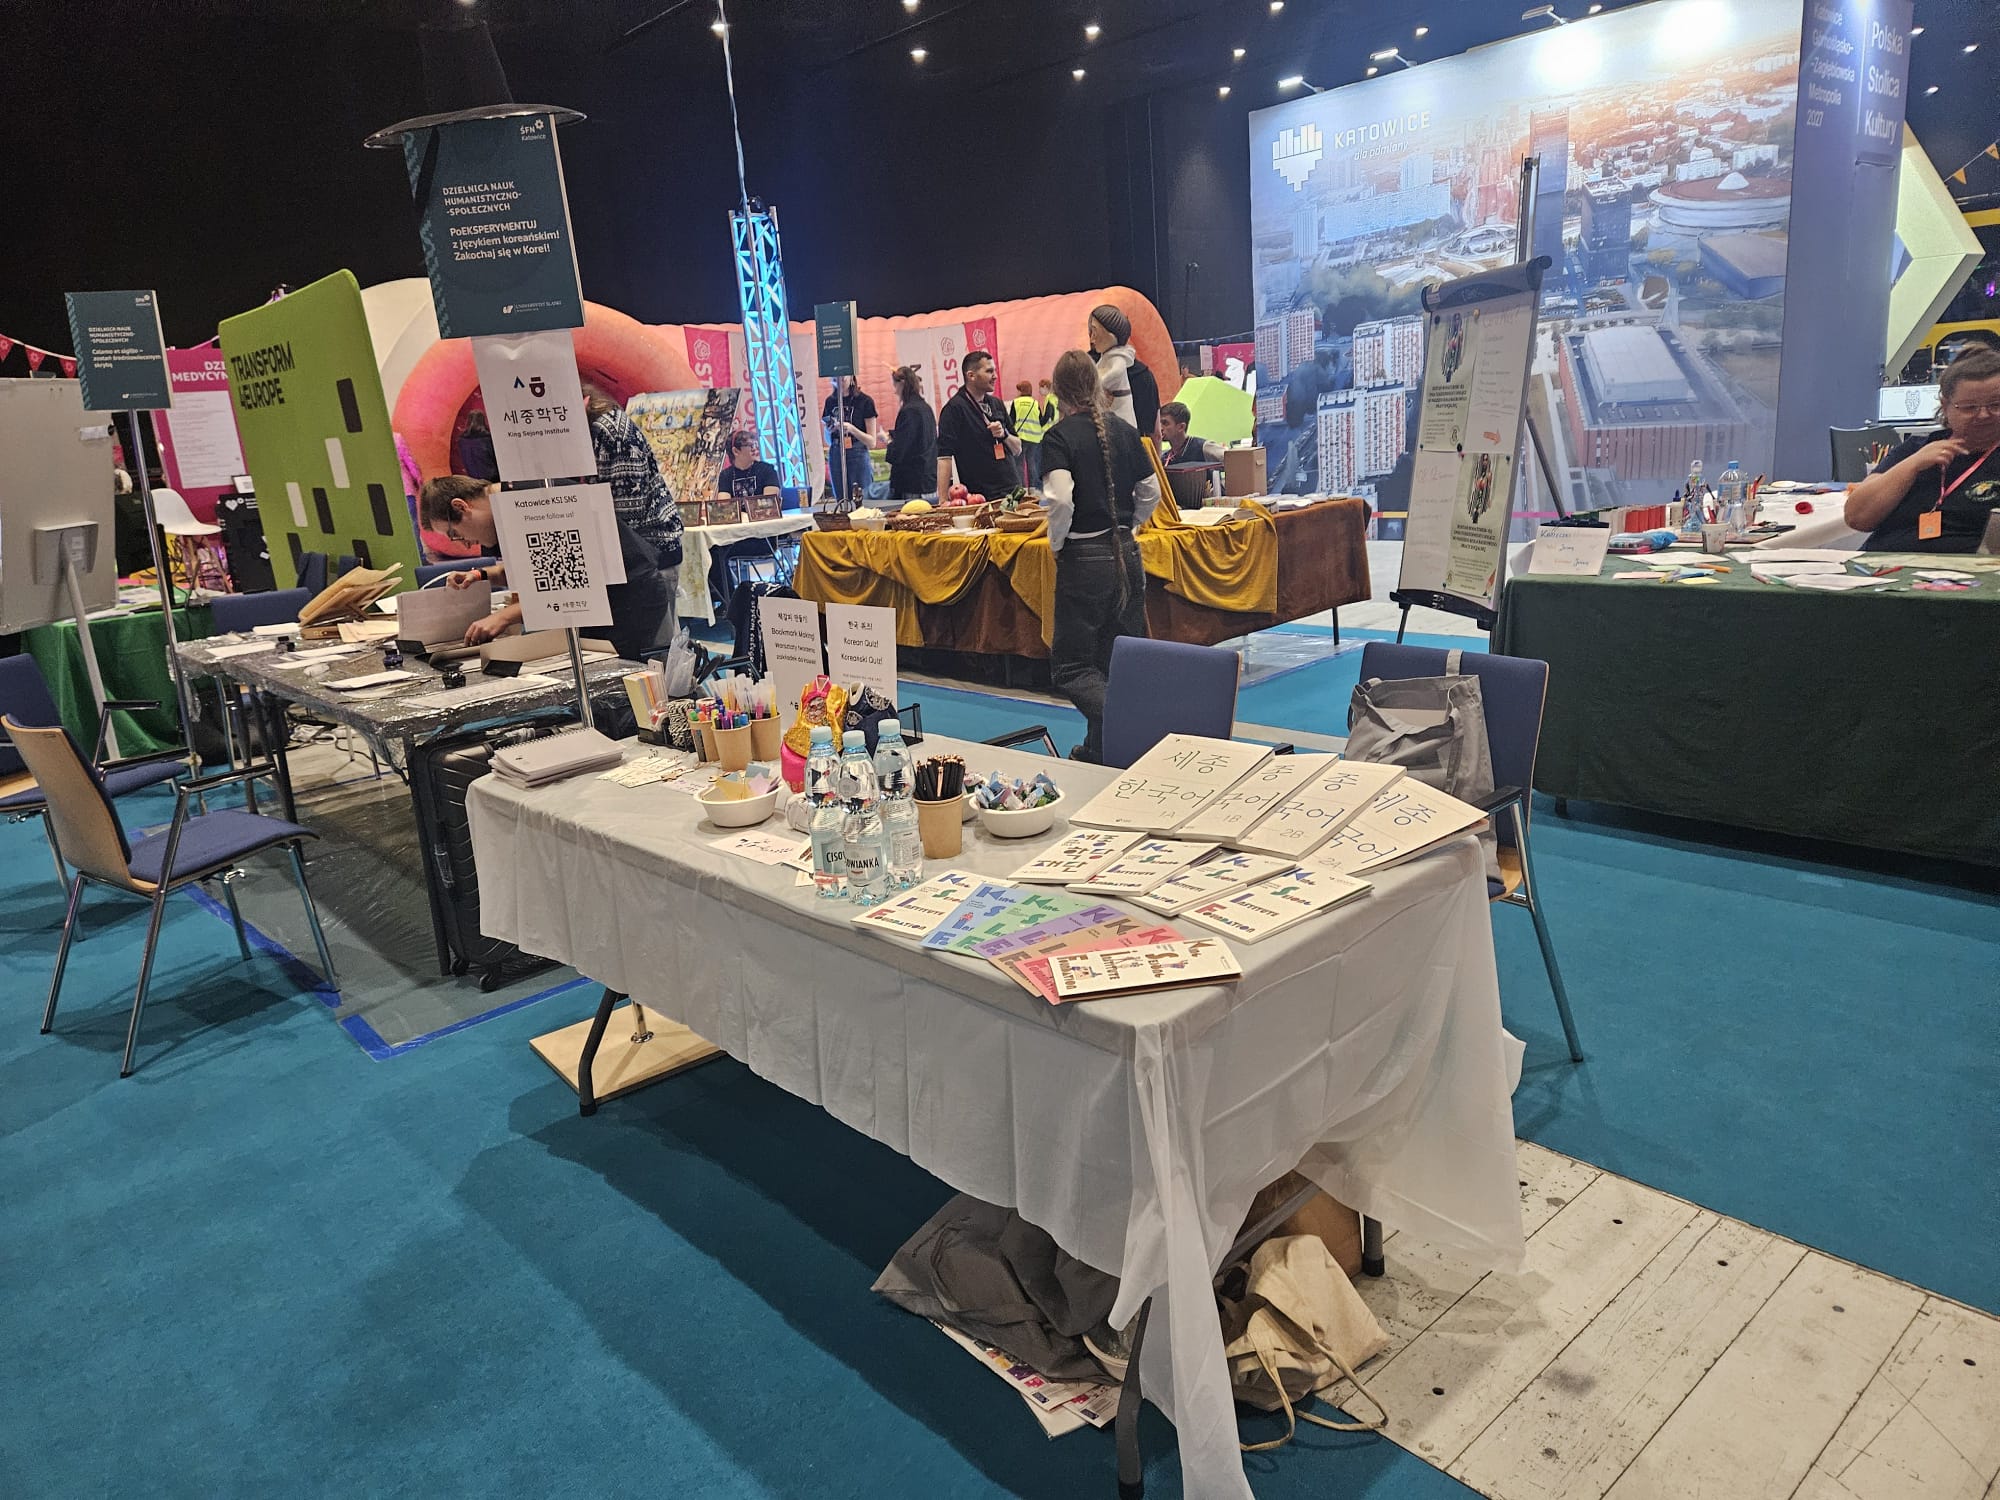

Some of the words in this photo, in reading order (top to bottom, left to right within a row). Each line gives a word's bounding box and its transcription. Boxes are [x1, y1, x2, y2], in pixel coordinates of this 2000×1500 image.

[1872, 21, 1903, 55] Polska
[1868, 65, 1899, 98] Stolica
[1808, 82, 1842, 106] Metropolia
[1806, 108, 1824, 126] 2027
[1334, 110, 1431, 148] KATOWICE
[1864, 110, 1898, 144] Kultury
[442, 184, 489, 196] DZIELNICA
[490, 181, 515, 191] NAUK
[444, 192, 522, 206] HUMANISTYCZNO-
[446, 203, 511, 216] -SPOŁECZNYCH
[450, 220, 537, 237] PoEKSPERYMENTUJ
[452, 241, 458, 249] z
[459, 237, 501, 250] językiem
[503, 230, 560, 244] koreańskim!
[454, 250, 496, 260] Zakochaj
[498, 248, 511, 258] się
[512, 247, 522, 256] w
[522, 244, 550, 254] Korei!
[231, 341, 296, 382] TRANSFORM
[172, 371, 229, 382] MEDYCYN
[504, 406, 568, 424] 세종학당
[514, 499, 550, 508] Katowice
[772, 628, 797, 636] Bookmark
[844, 637, 863, 646] Korean
[865, 640, 879, 648] Quiz!
[1163, 750, 1231, 774] 세종
[1262, 764, 1295, 781] 종
[1322, 772, 1360, 791] 종
[1114, 778, 1214, 808] 한국어
[1212, 792, 1280, 811] 국어
[1275, 800, 1345, 829] 국어
[1072, 834, 1119, 846] 세종
[1330, 825, 1397, 864] 국어
[1064, 847, 1115, 860] 학당
